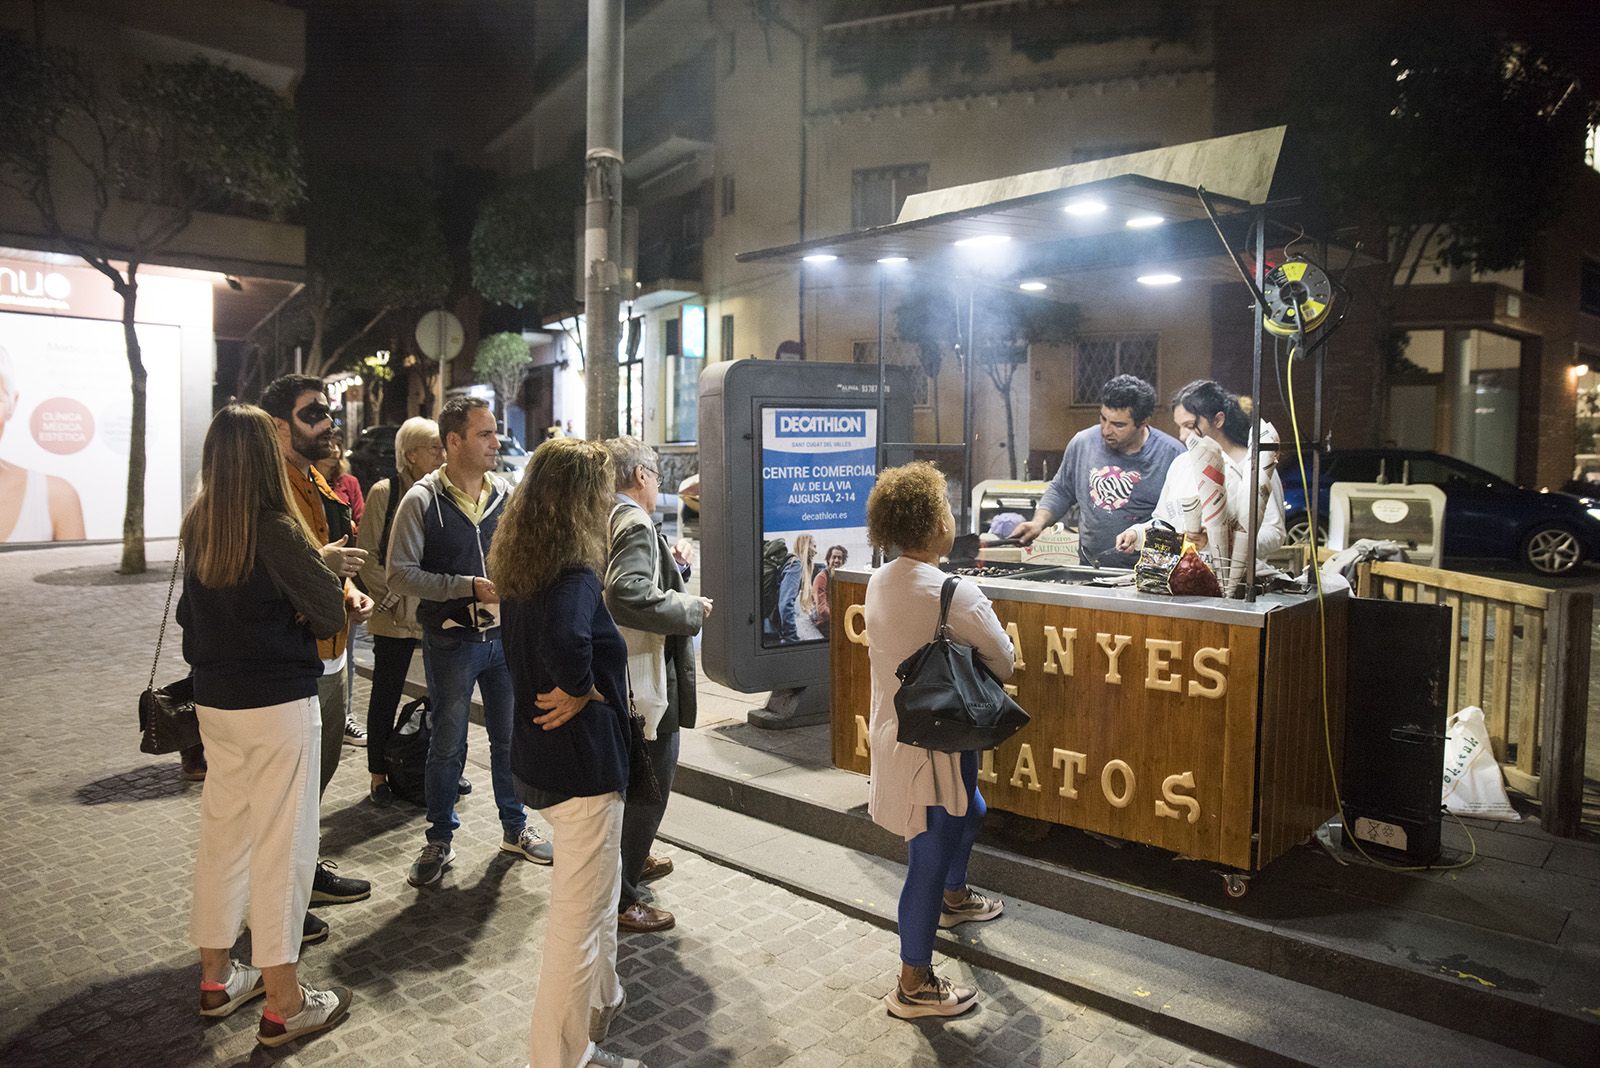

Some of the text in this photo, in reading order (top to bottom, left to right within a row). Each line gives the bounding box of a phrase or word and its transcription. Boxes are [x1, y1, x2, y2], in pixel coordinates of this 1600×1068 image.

[780, 416, 862, 433] DECATHLON
[762, 466, 810, 480] CENTRE
[792, 480, 852, 492] AV. DE LA VIA
[788, 492, 856, 504] AUGUSTA, 2-14
[801, 511, 848, 521] decathlon.es
